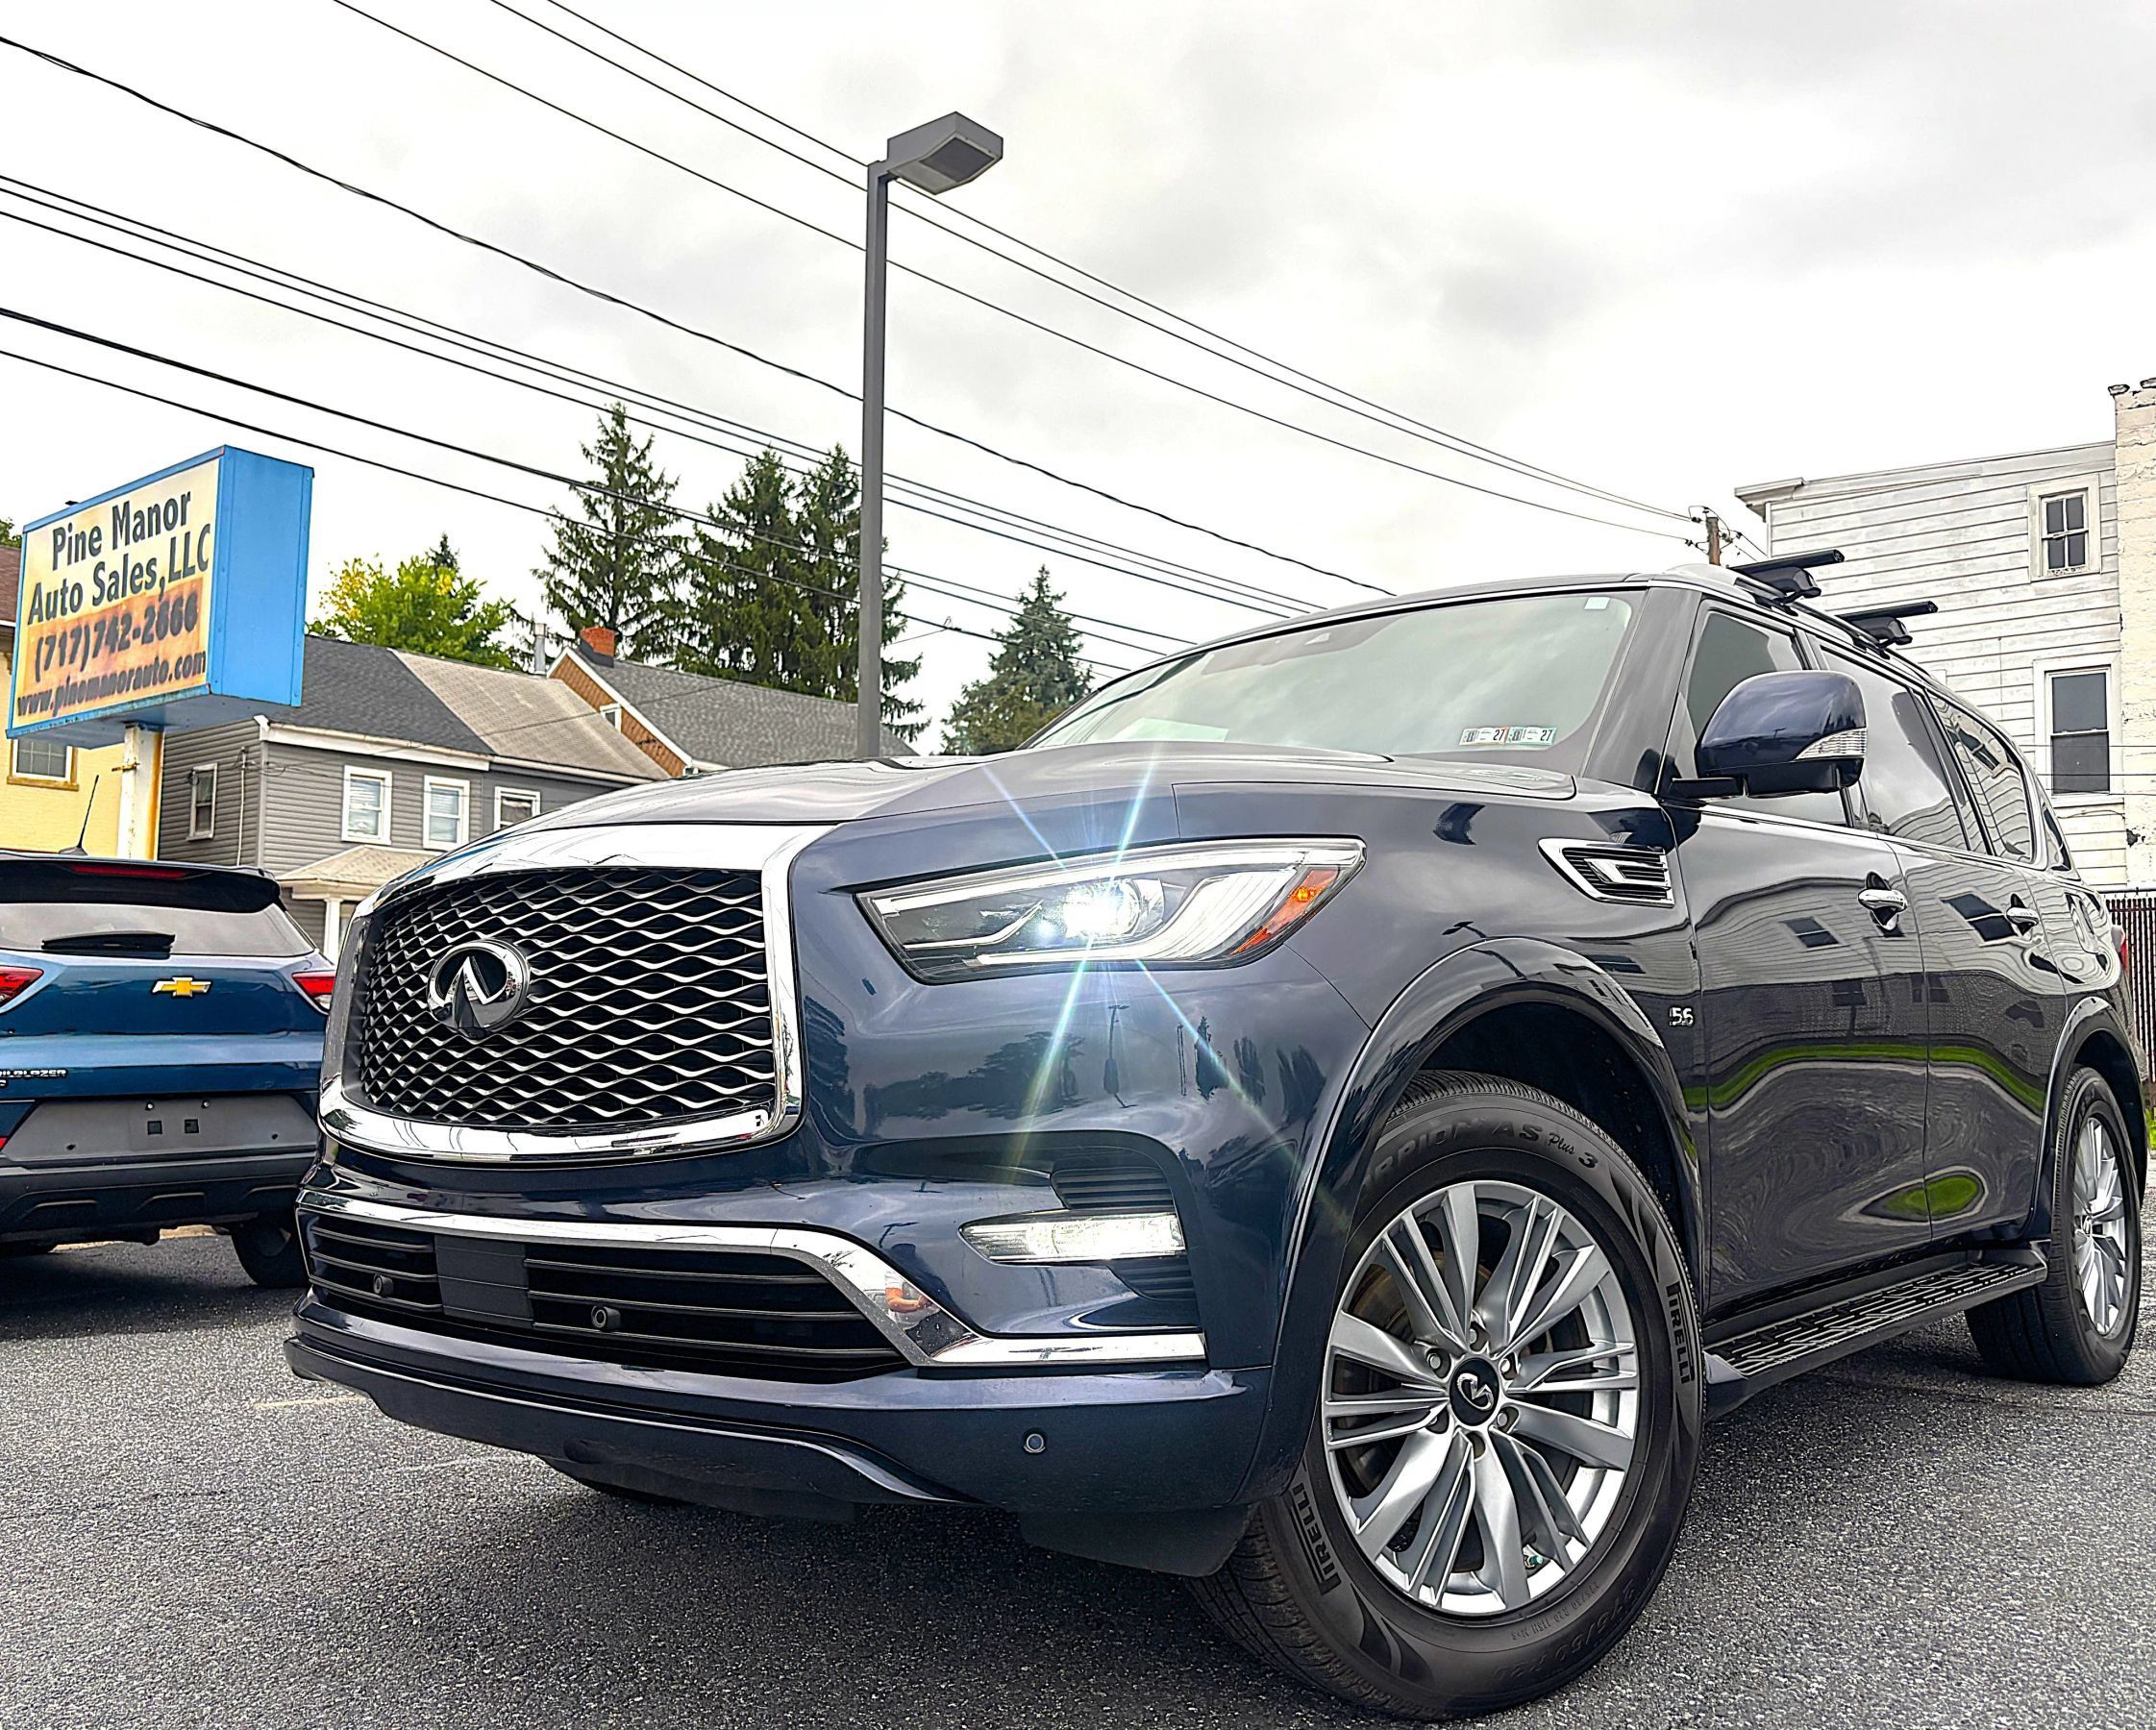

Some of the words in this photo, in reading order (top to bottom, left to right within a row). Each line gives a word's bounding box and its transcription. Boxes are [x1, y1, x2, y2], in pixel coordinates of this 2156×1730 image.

[52, 522, 102, 570] Pine
[112, 491, 191, 551] Manor
[27, 579, 83, 625] Auto
[1493, 729, 1505, 742] 27
[1540, 729, 1553, 743] 27
[0, 1069, 67, 1077] ILBLAZER
[1549, 1131, 1576, 1155] Plus
[1578, 1151, 1598, 1169] 3
[1666, 1280, 1695, 1384] PIRELLI
[1287, 1482, 1342, 1595] PIRELLI
